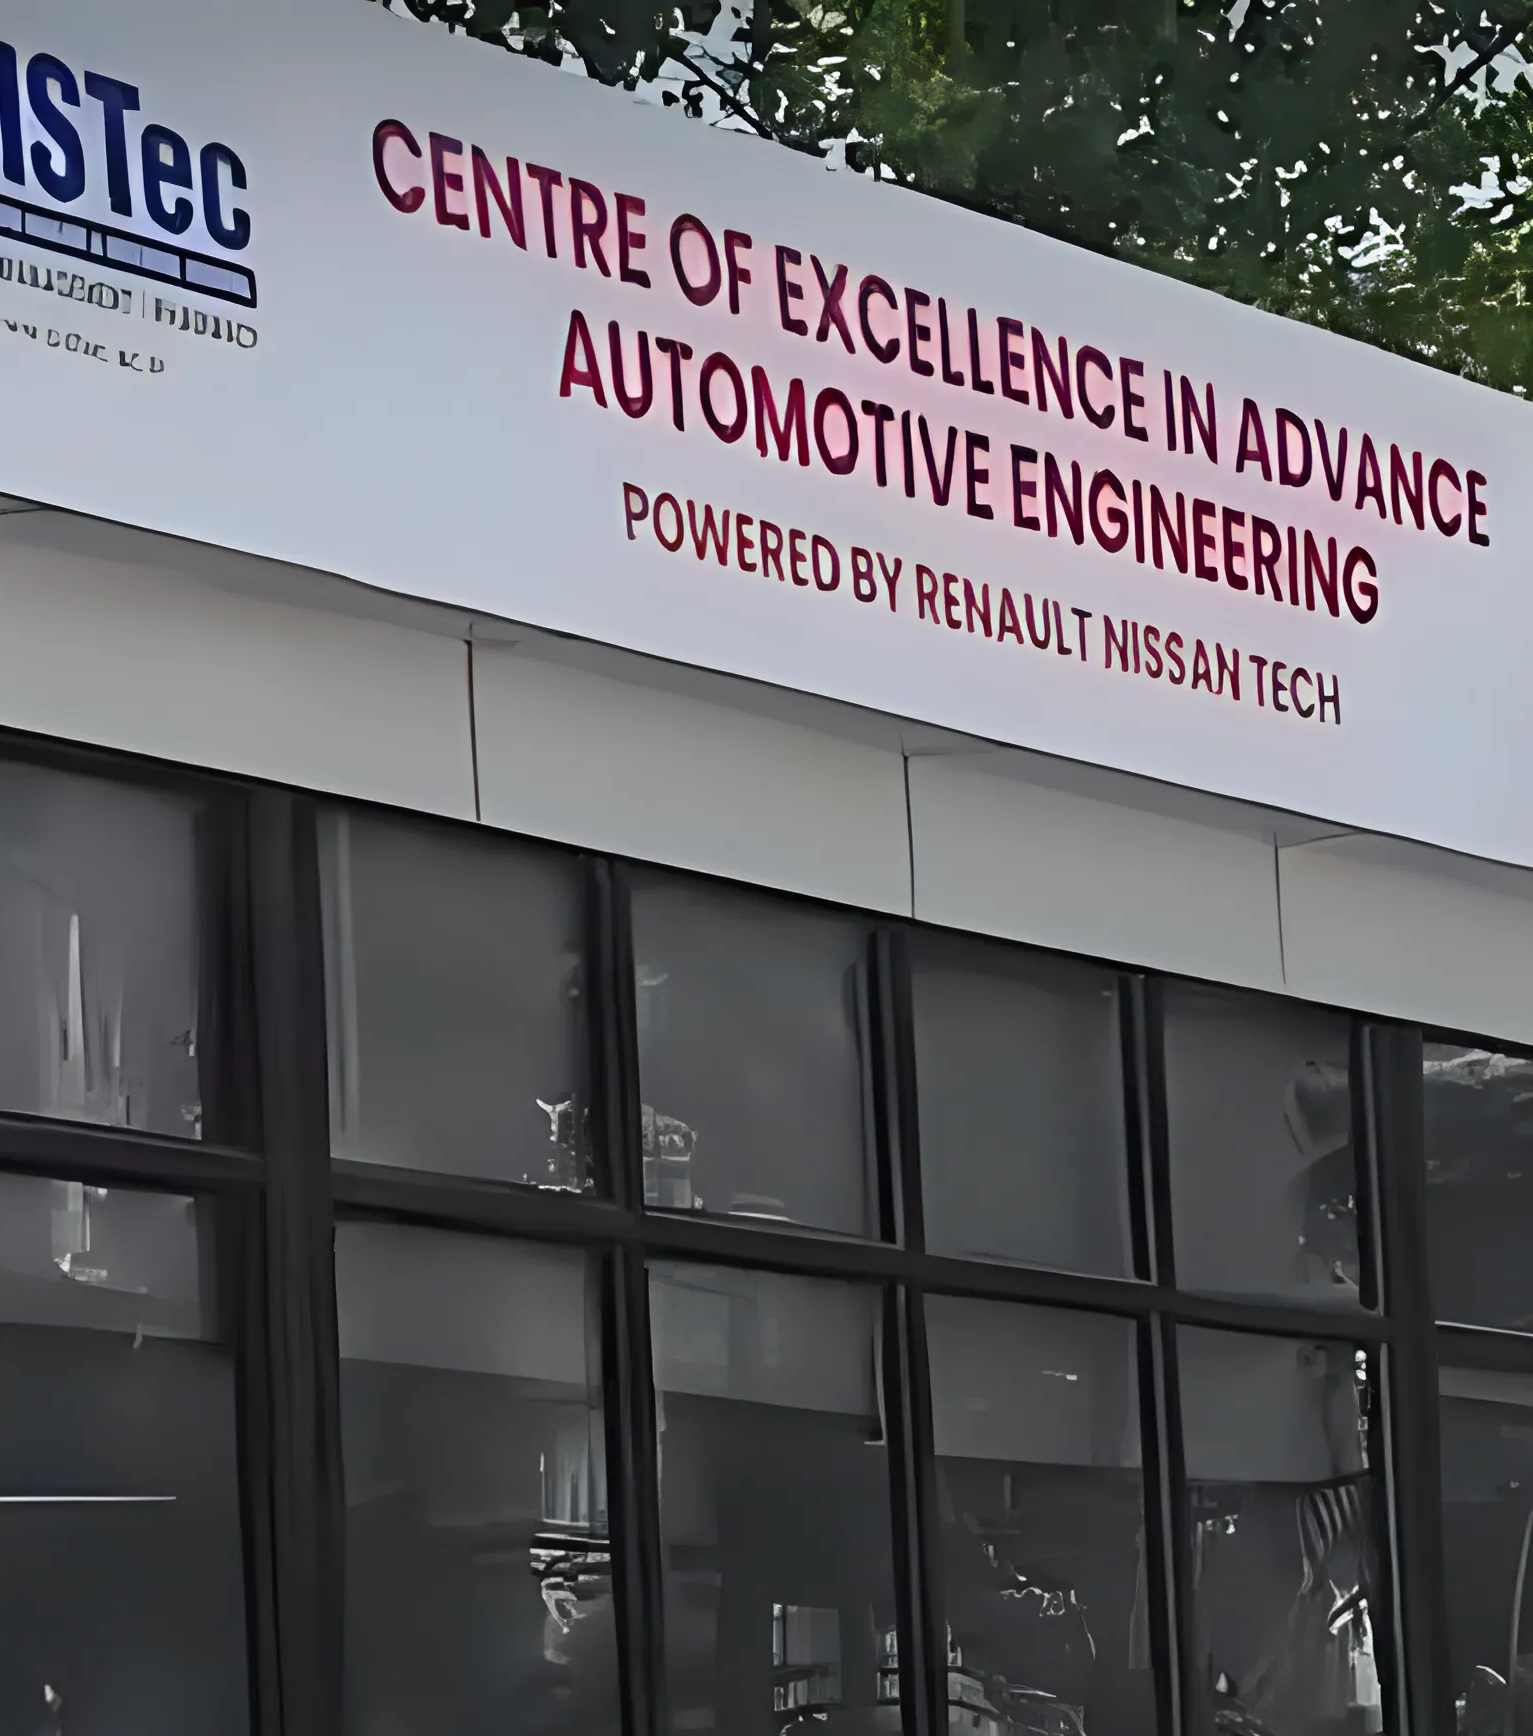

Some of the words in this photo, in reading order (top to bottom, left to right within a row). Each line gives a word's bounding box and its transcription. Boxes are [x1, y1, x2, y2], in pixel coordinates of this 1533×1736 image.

[373, 119, 651, 288] CENTRE
[669, 213, 752, 314] OF
[775, 245, 1149, 442] EXCELLENCE
[1164, 369, 1218, 464] IN
[1236, 397, 1490, 546] ADVANCE
[559, 309, 994, 520] AUTOMOTIVE
[1010, 443, 1379, 624] ENGINEERING
[623, 482, 840, 591] POWERED
[851, 546, 902, 612] BY
[916, 563, 1092, 662] RENAULT
[1103, 614, 1240, 700] NISSAN
[1249, 655, 1341, 725] TECH
